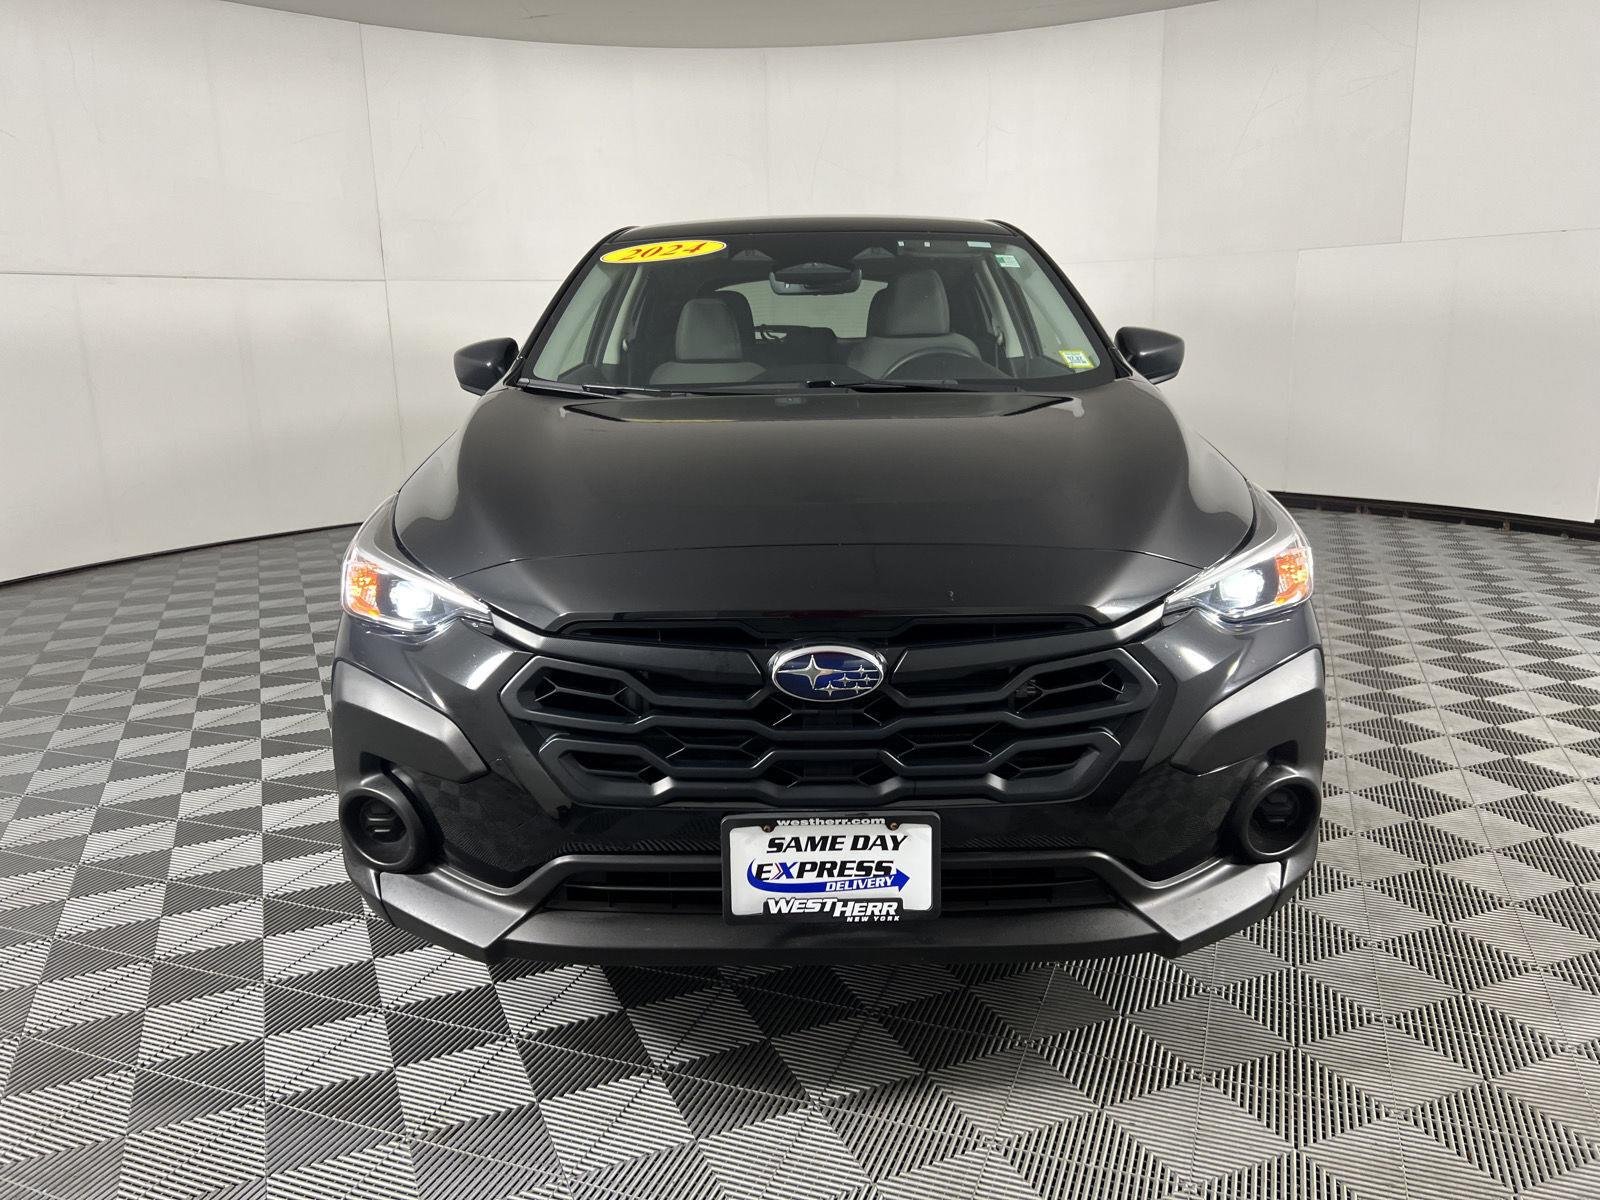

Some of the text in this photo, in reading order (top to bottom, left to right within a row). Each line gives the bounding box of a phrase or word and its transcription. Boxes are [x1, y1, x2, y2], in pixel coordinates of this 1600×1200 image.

[618, 242, 709, 261] 2024
[776, 817, 886, 826] westherr.com
[766, 834, 908, 854] SAME DAY
[755, 860, 894, 881] EXPRESS
[825, 875, 896, 892] DELIVERY
[846, 915, 872, 923] NEW
